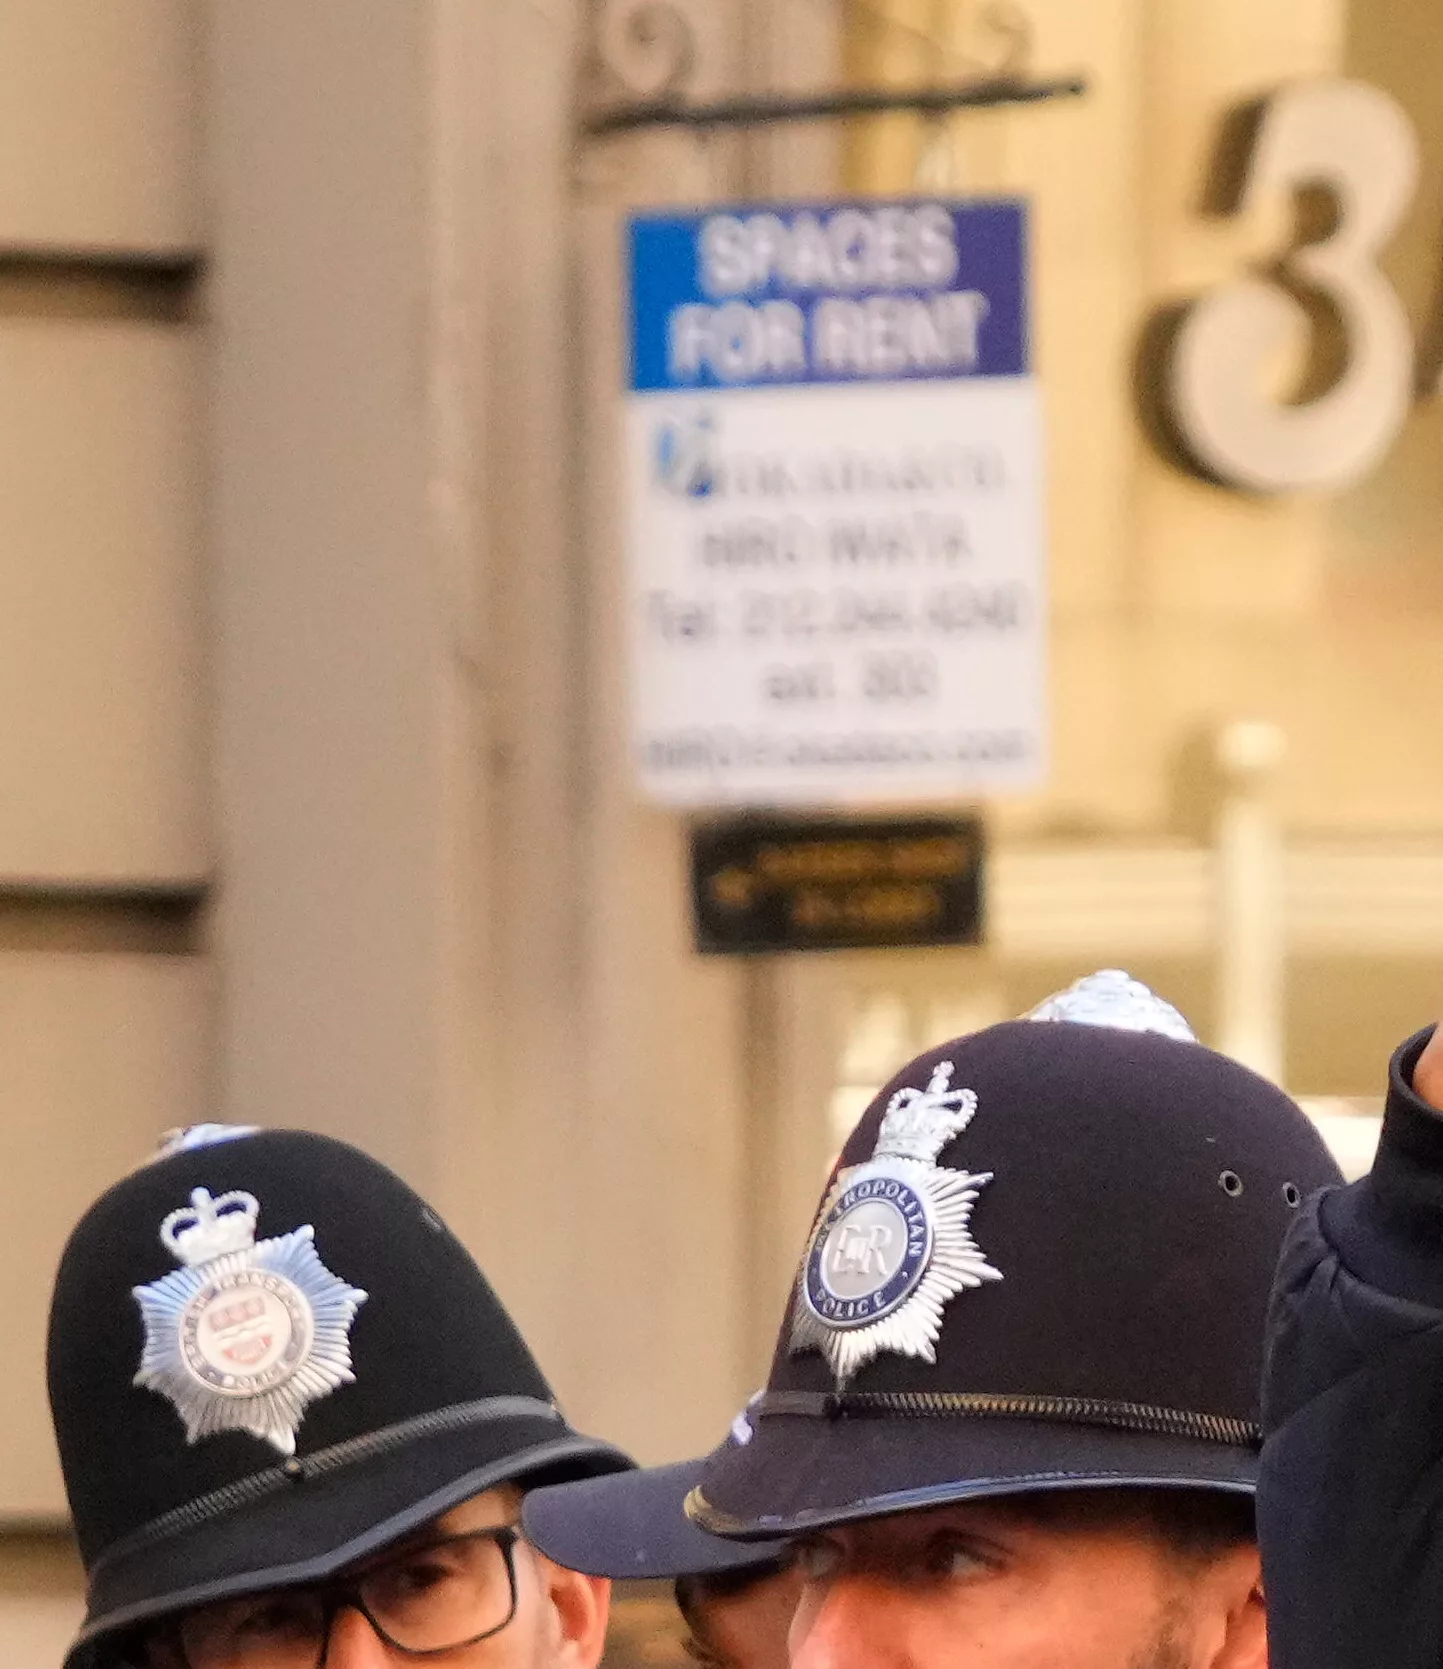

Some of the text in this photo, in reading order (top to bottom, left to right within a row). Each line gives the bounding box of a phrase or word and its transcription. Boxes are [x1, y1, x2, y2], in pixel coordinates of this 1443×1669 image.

[701, 205, 958, 297] SPACES
[668, 290, 989, 382] FOR RENT
[815, 1289, 887, 1318] POLICE
